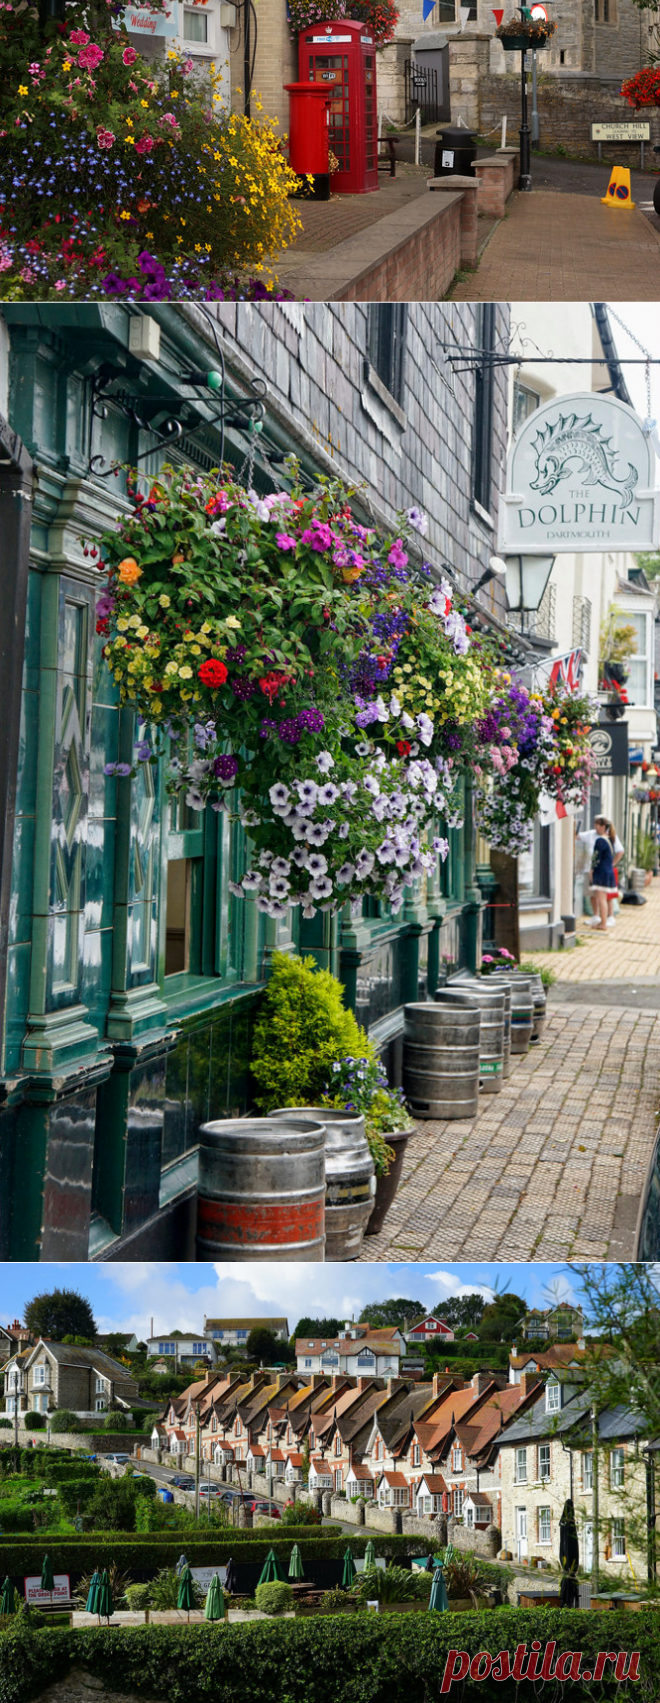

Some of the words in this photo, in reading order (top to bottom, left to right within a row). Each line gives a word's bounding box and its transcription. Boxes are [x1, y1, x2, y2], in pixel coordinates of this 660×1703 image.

[130, 13, 157, 33] Wedding
[569, 489, 590, 498] THE
[517, 503, 641, 529] DOLPHIN
[546, 530, 611, 539] DARTMOUTH
